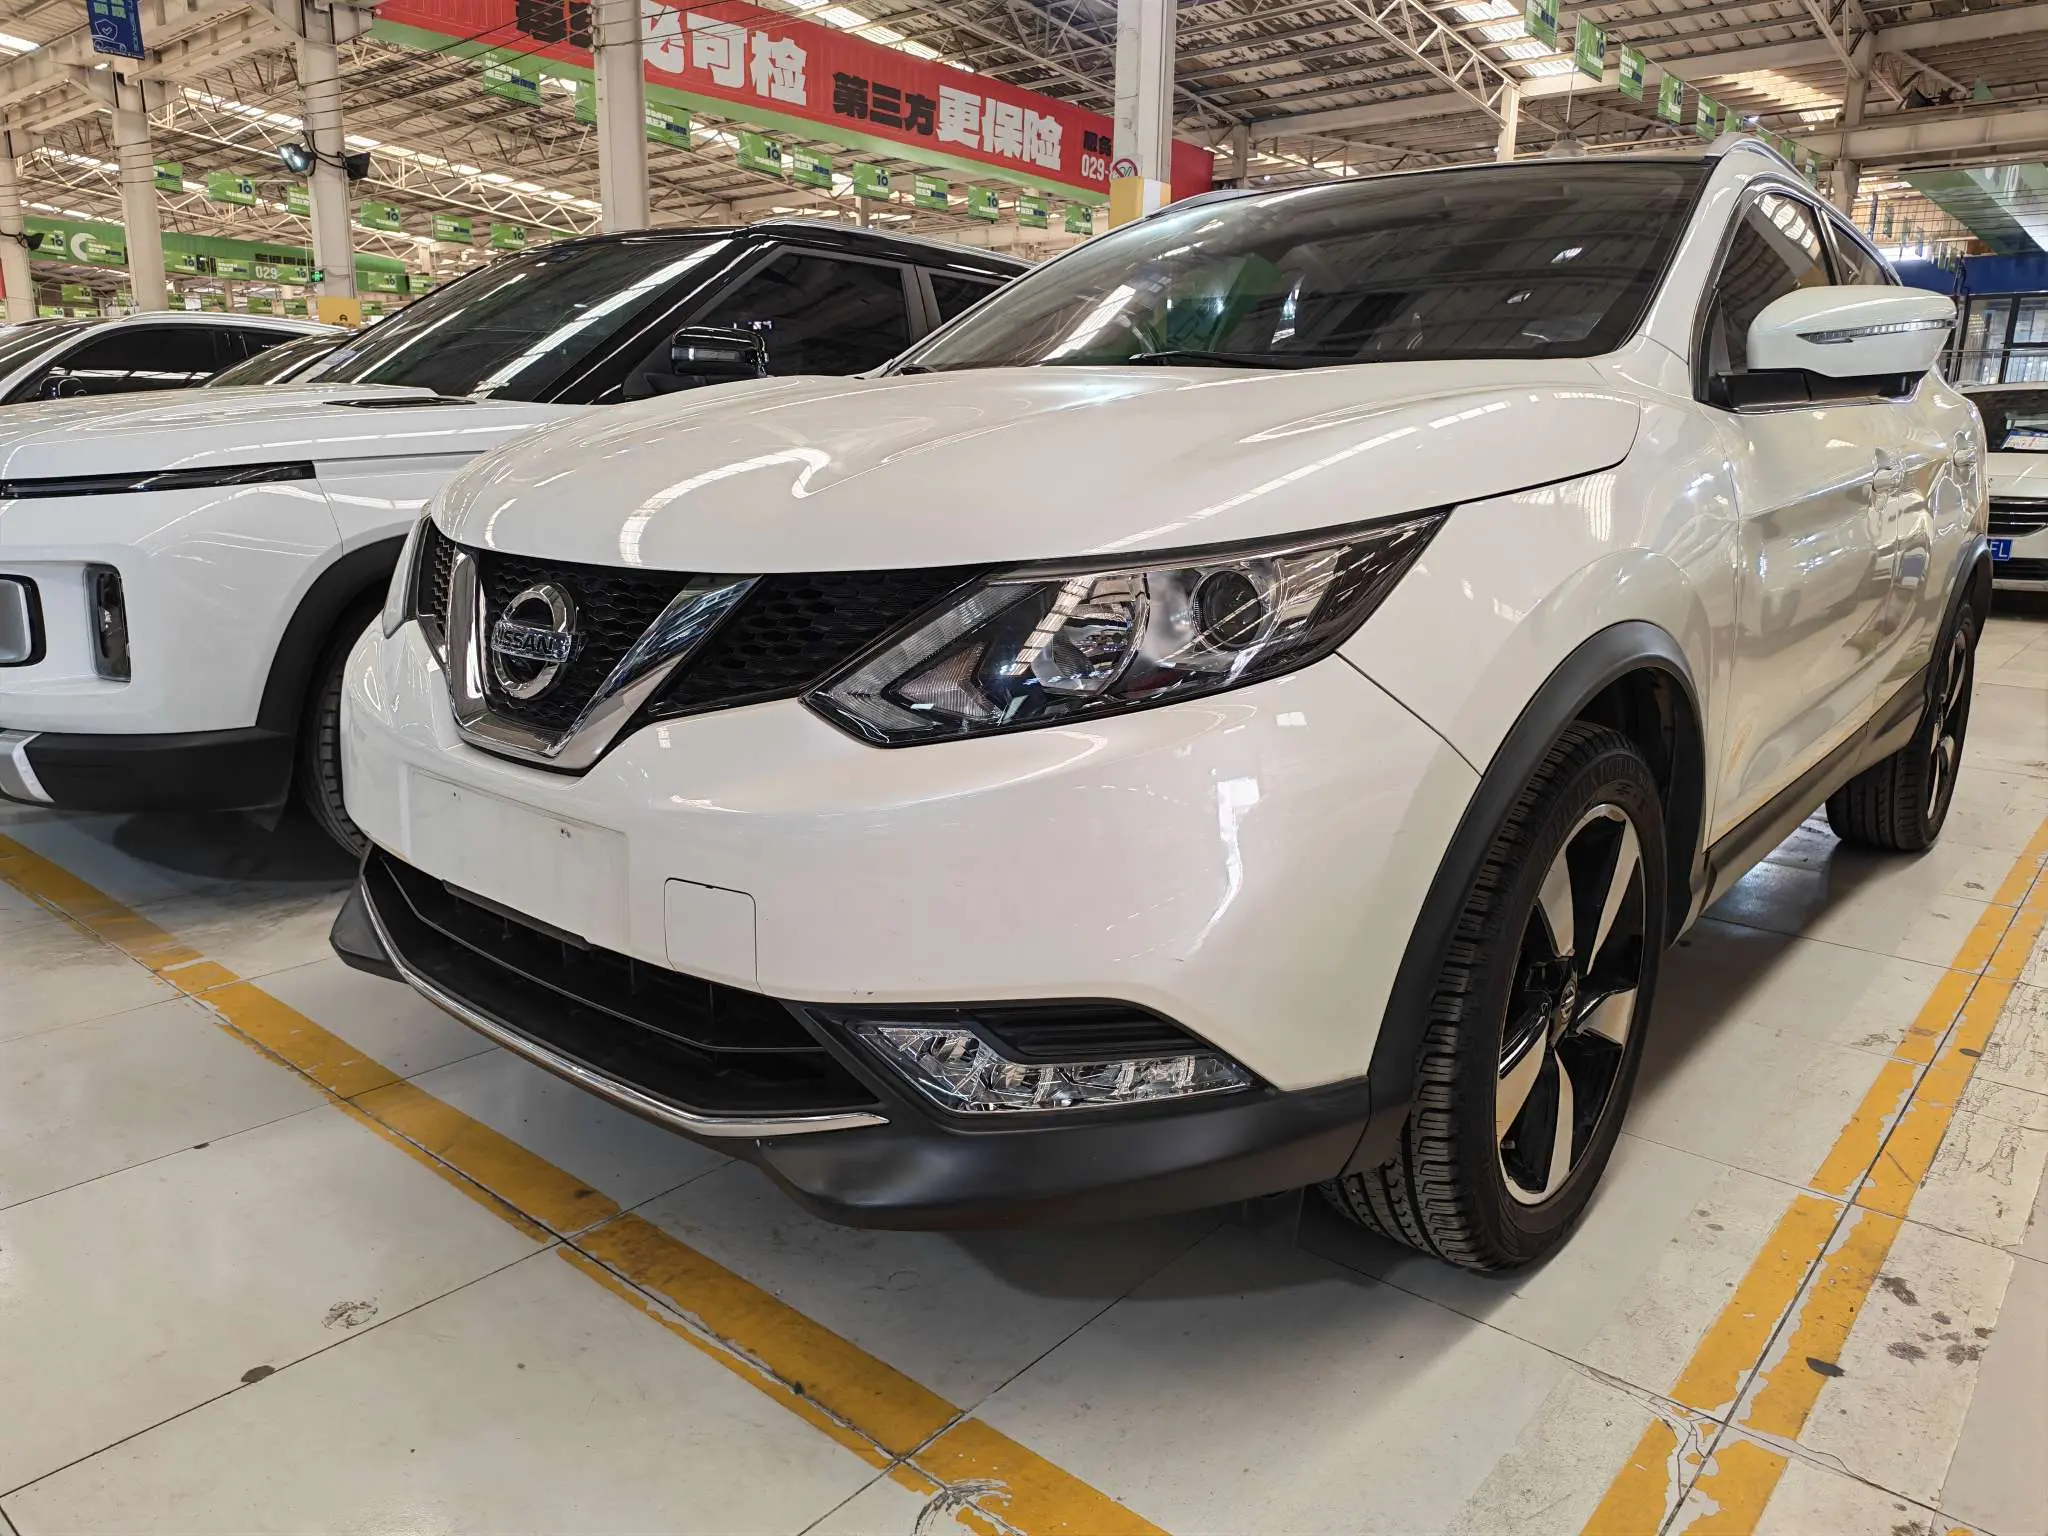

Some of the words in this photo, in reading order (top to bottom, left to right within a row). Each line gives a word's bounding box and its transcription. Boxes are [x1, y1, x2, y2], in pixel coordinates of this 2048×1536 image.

[833, 72, 1064, 171] 第三方更保险
[766, 146, 780, 161] 10
[876, 174, 889, 187] 10
[239, 183, 253, 195] 10
[987, 195, 999, 208] 10
[386, 210, 399, 222] 10
[513, 229, 525, 241] 10
[255, 265, 278, 280] 029
[1989, 541, 2008, 558] FL
